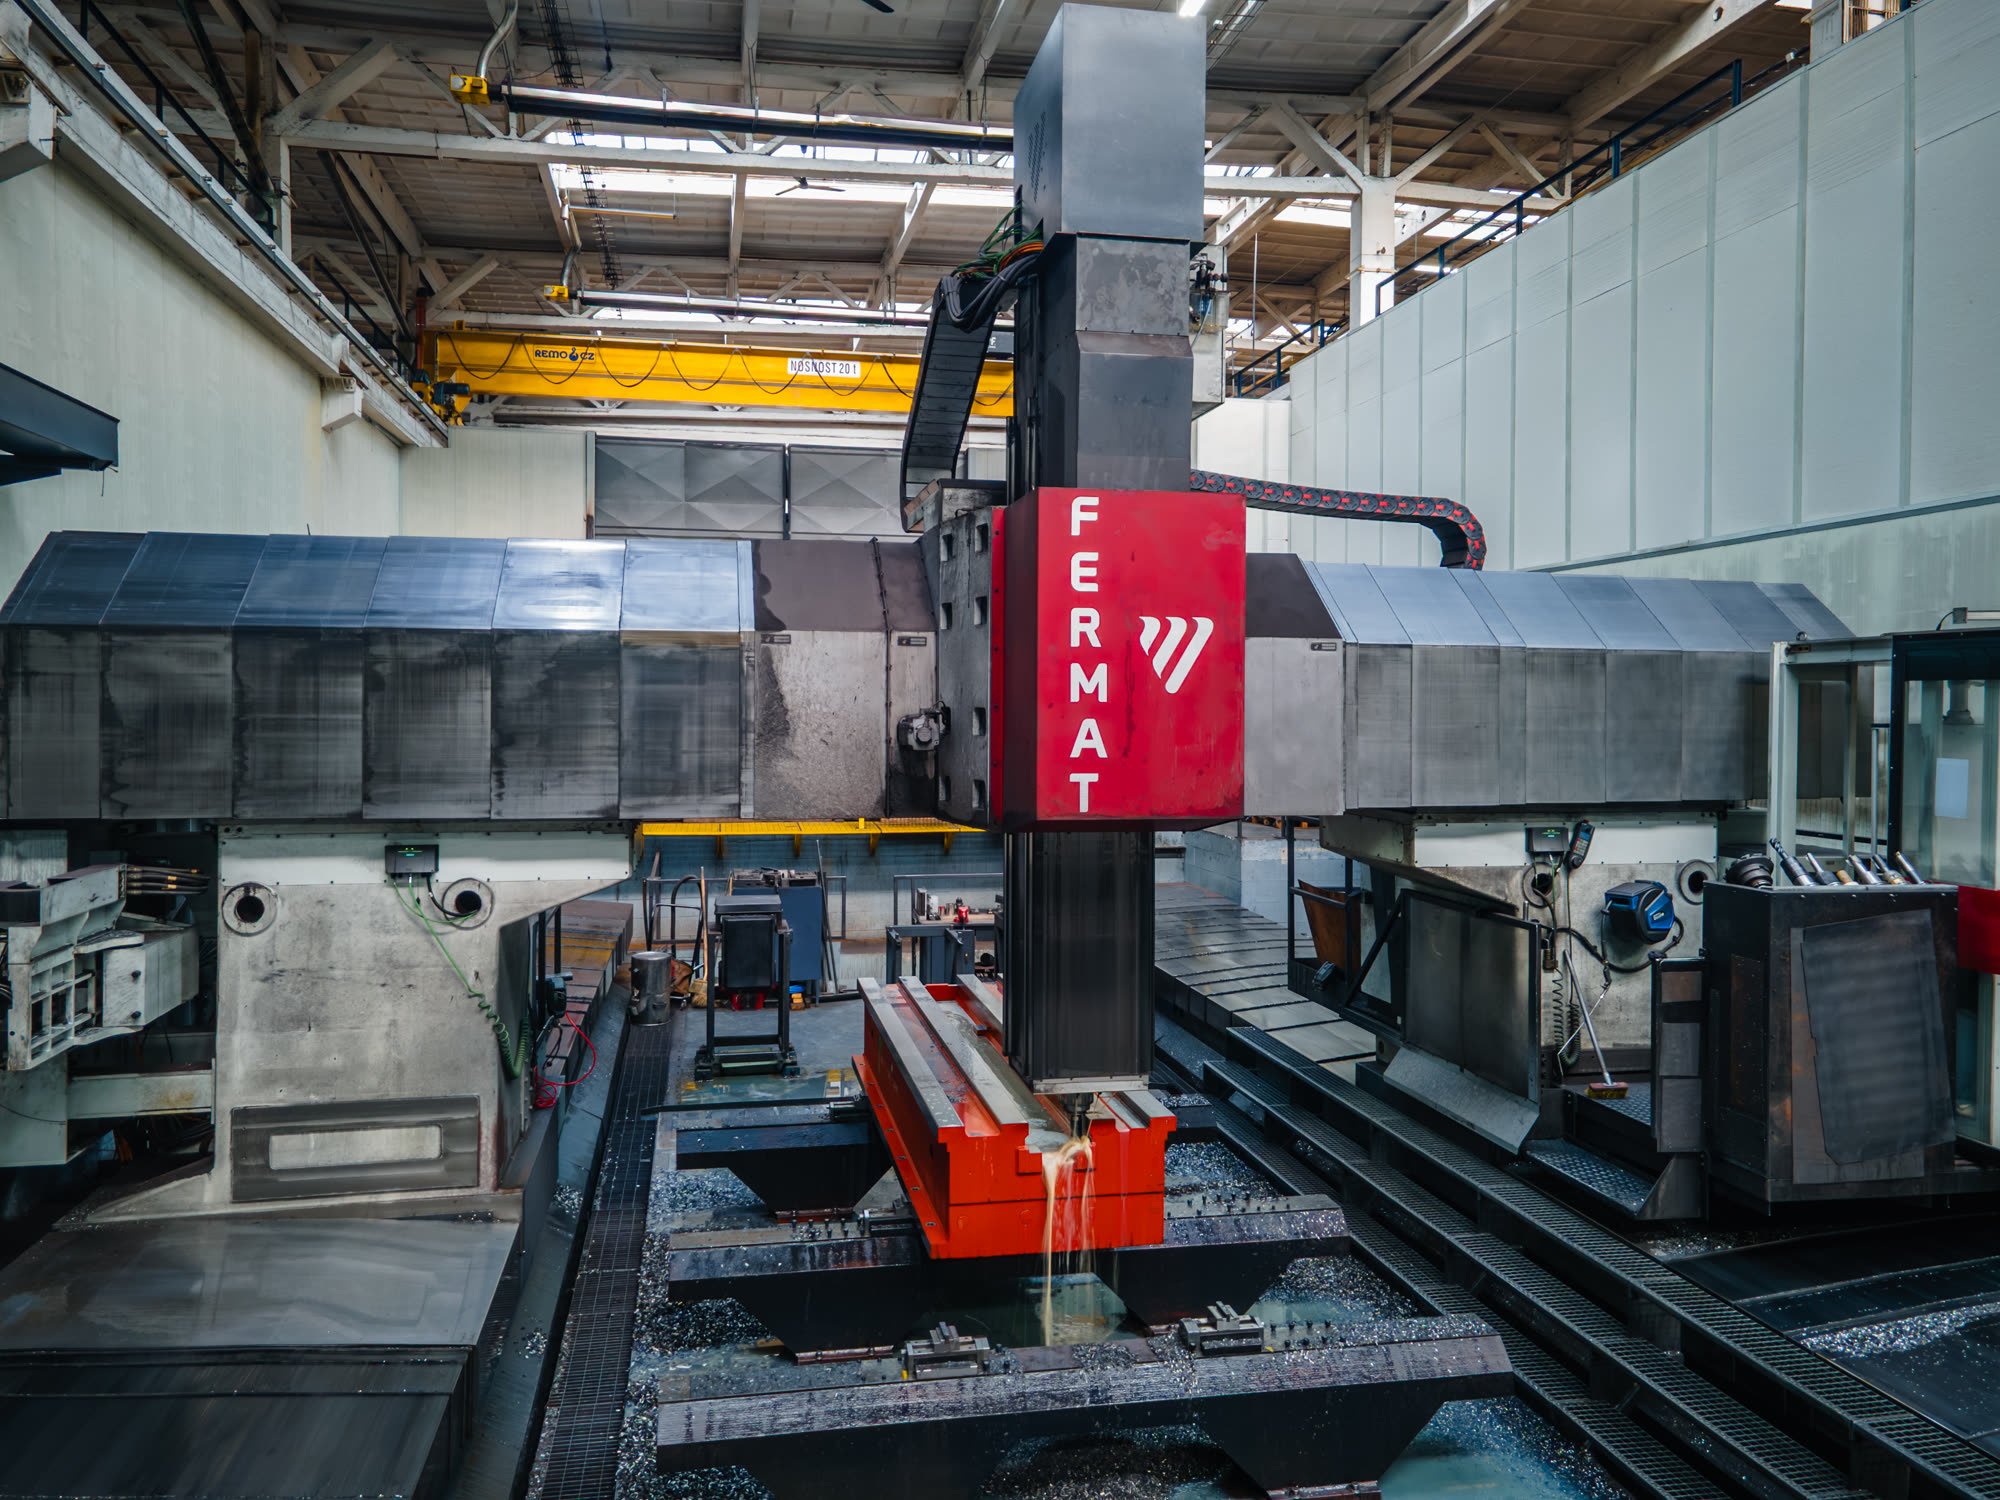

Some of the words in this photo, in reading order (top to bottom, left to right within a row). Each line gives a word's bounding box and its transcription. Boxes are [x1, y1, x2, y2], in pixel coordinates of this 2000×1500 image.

[535, 349, 568, 359] REMO
[839, 363, 850, 374] 20
[1070, 496, 1108, 813] FERMAT
